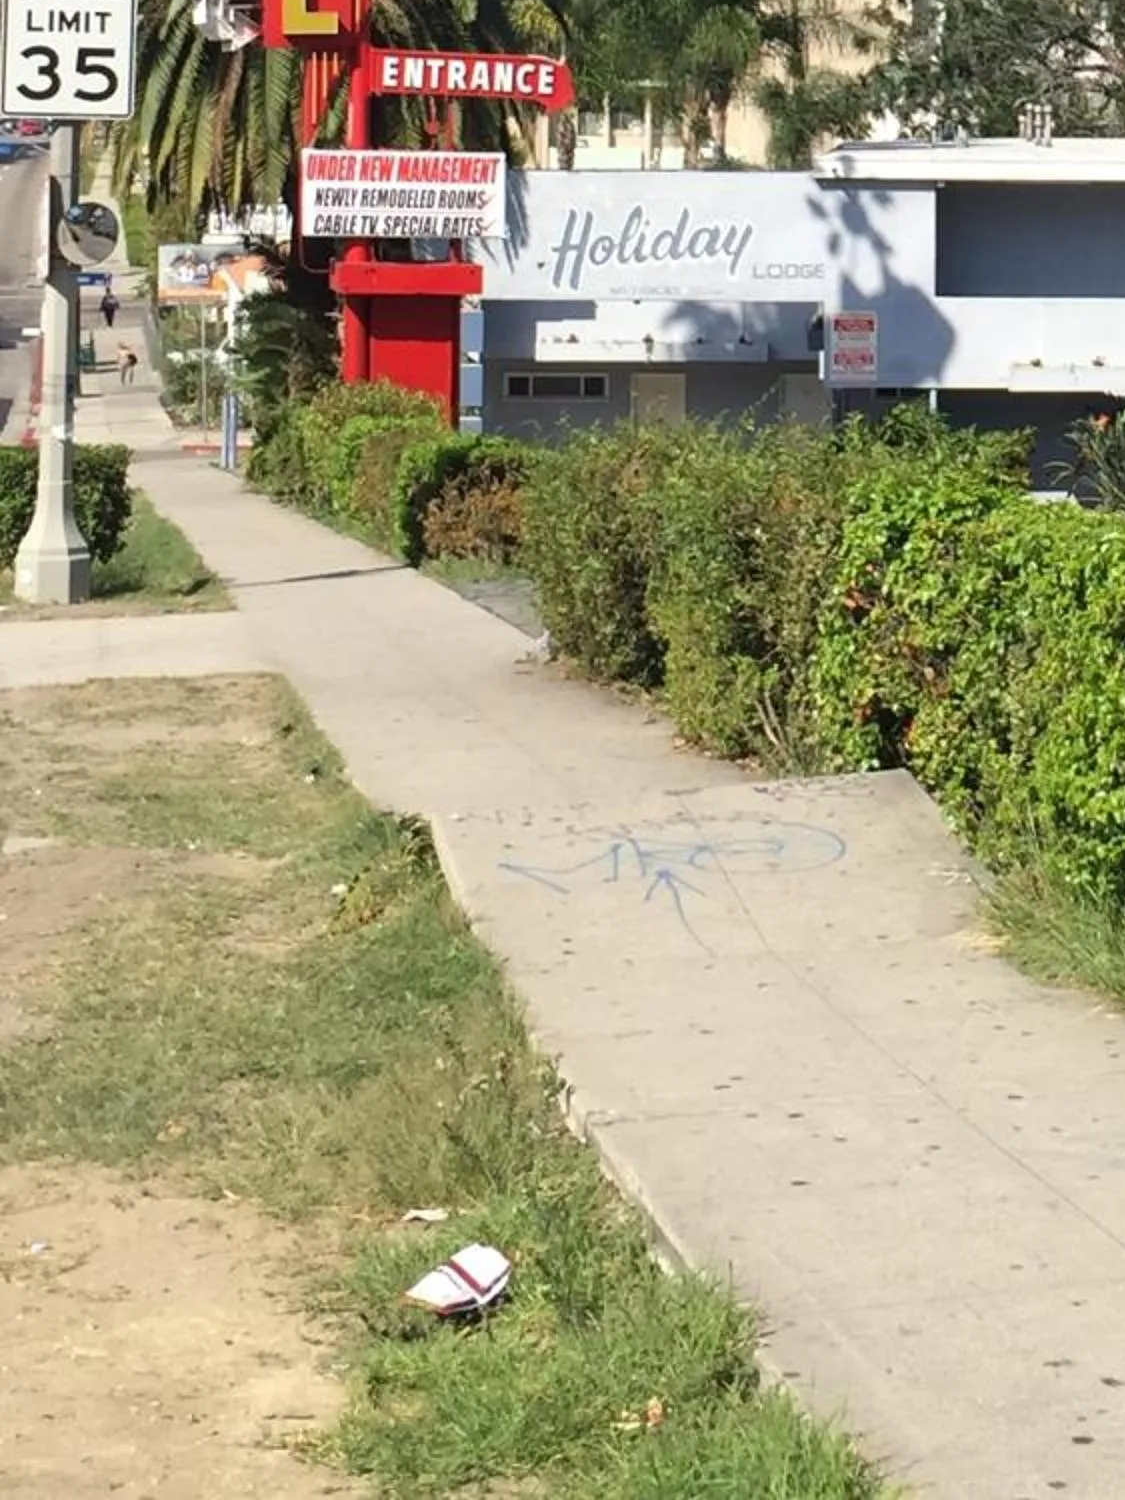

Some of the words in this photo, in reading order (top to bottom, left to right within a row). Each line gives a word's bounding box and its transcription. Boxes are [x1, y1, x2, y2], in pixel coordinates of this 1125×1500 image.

[26, 9, 112, 34] LIMIT
[16, 45, 118, 102] 35
[382, 55, 555, 95] ENTRANCE
[306, 154, 357, 182] UNDER
[359, 156, 395, 183] NEW
[396, 156, 501, 185] MANAGEMENT
[314, 187, 359, 208] NEWLY
[359, 188, 437, 210] REMODELED
[438, 189, 487, 211] ROOMS
[313, 214, 358, 235] CABLE
[382, 215, 438, 237] SPECIAL
[440, 217, 485, 238] RATES
[552, 206, 753, 290] Holiday
[752, 263, 825, 280] LODGE
